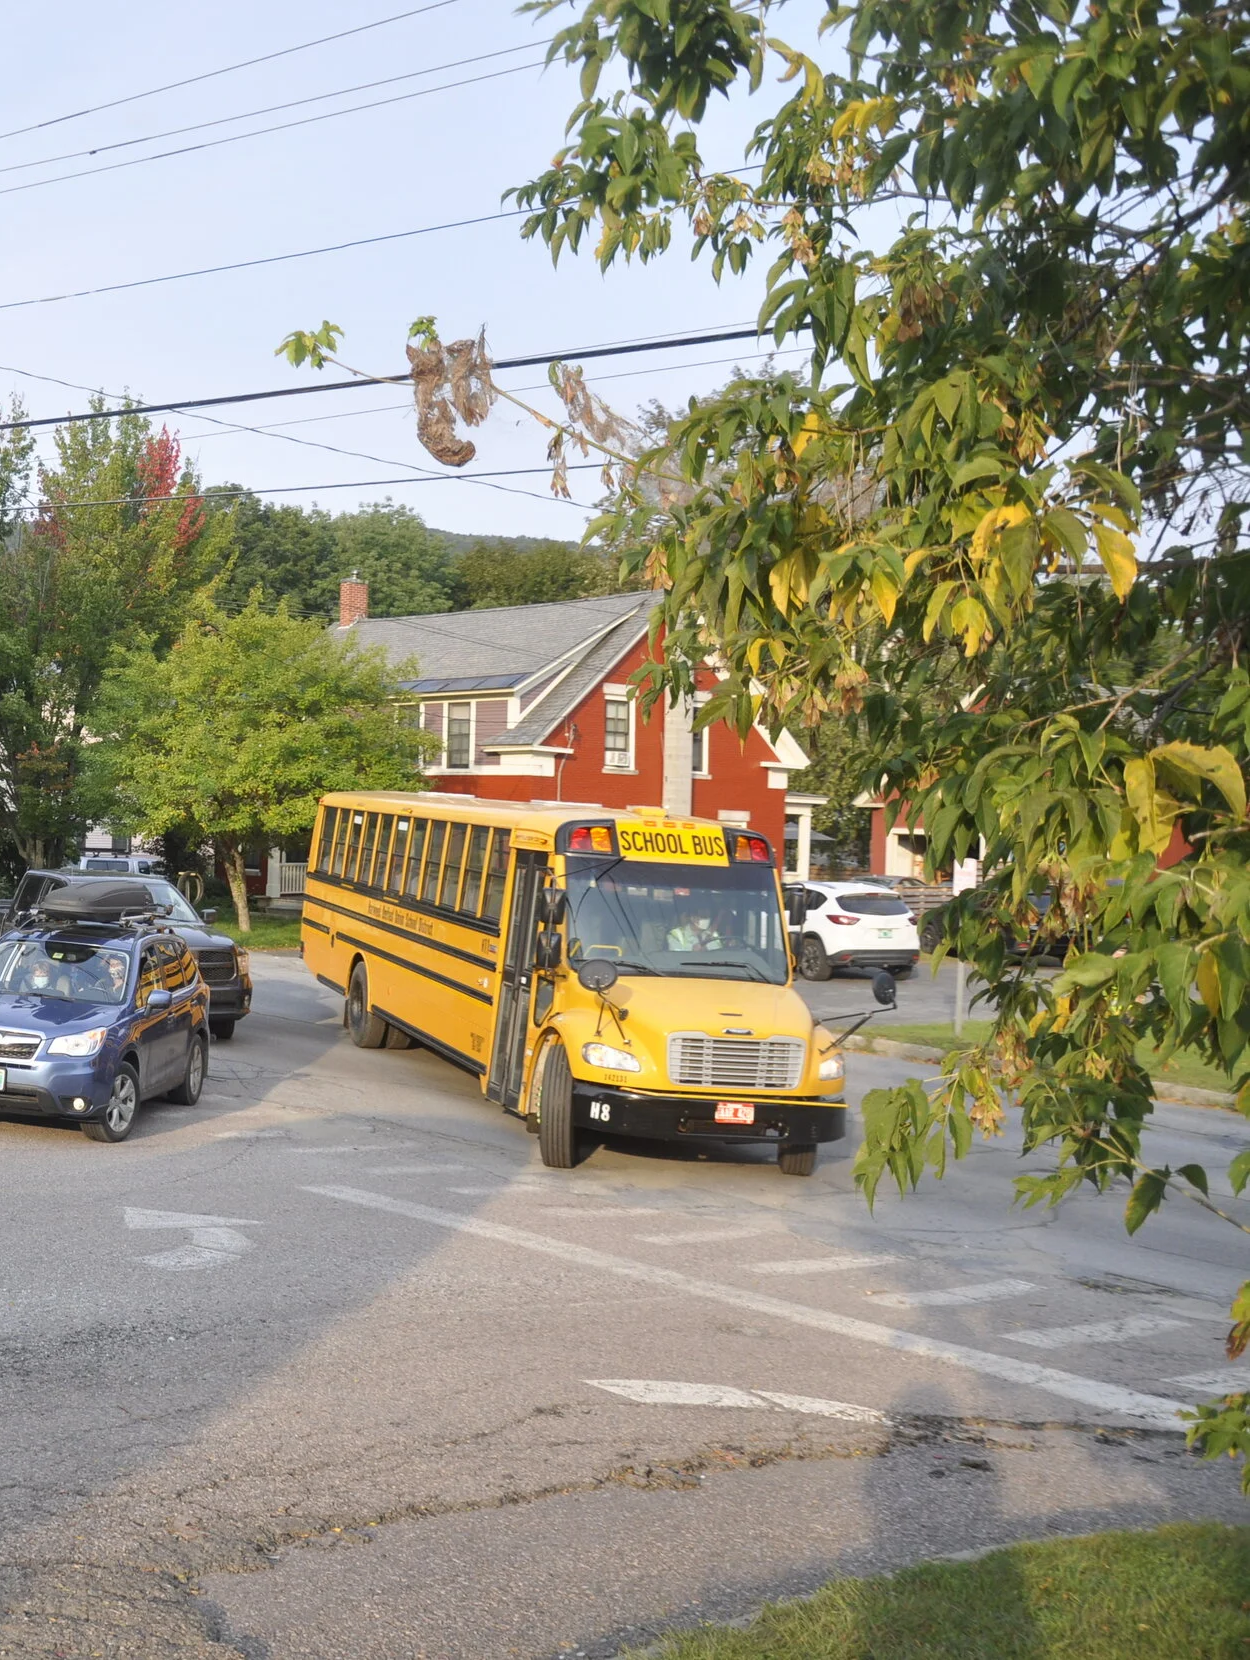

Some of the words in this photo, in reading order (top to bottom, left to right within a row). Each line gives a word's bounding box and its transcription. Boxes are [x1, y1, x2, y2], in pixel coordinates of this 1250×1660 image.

[620, 830, 689, 854] SCHOOL
[692, 835, 724, 857] BUS
[589, 1101, 611, 1122] H8
